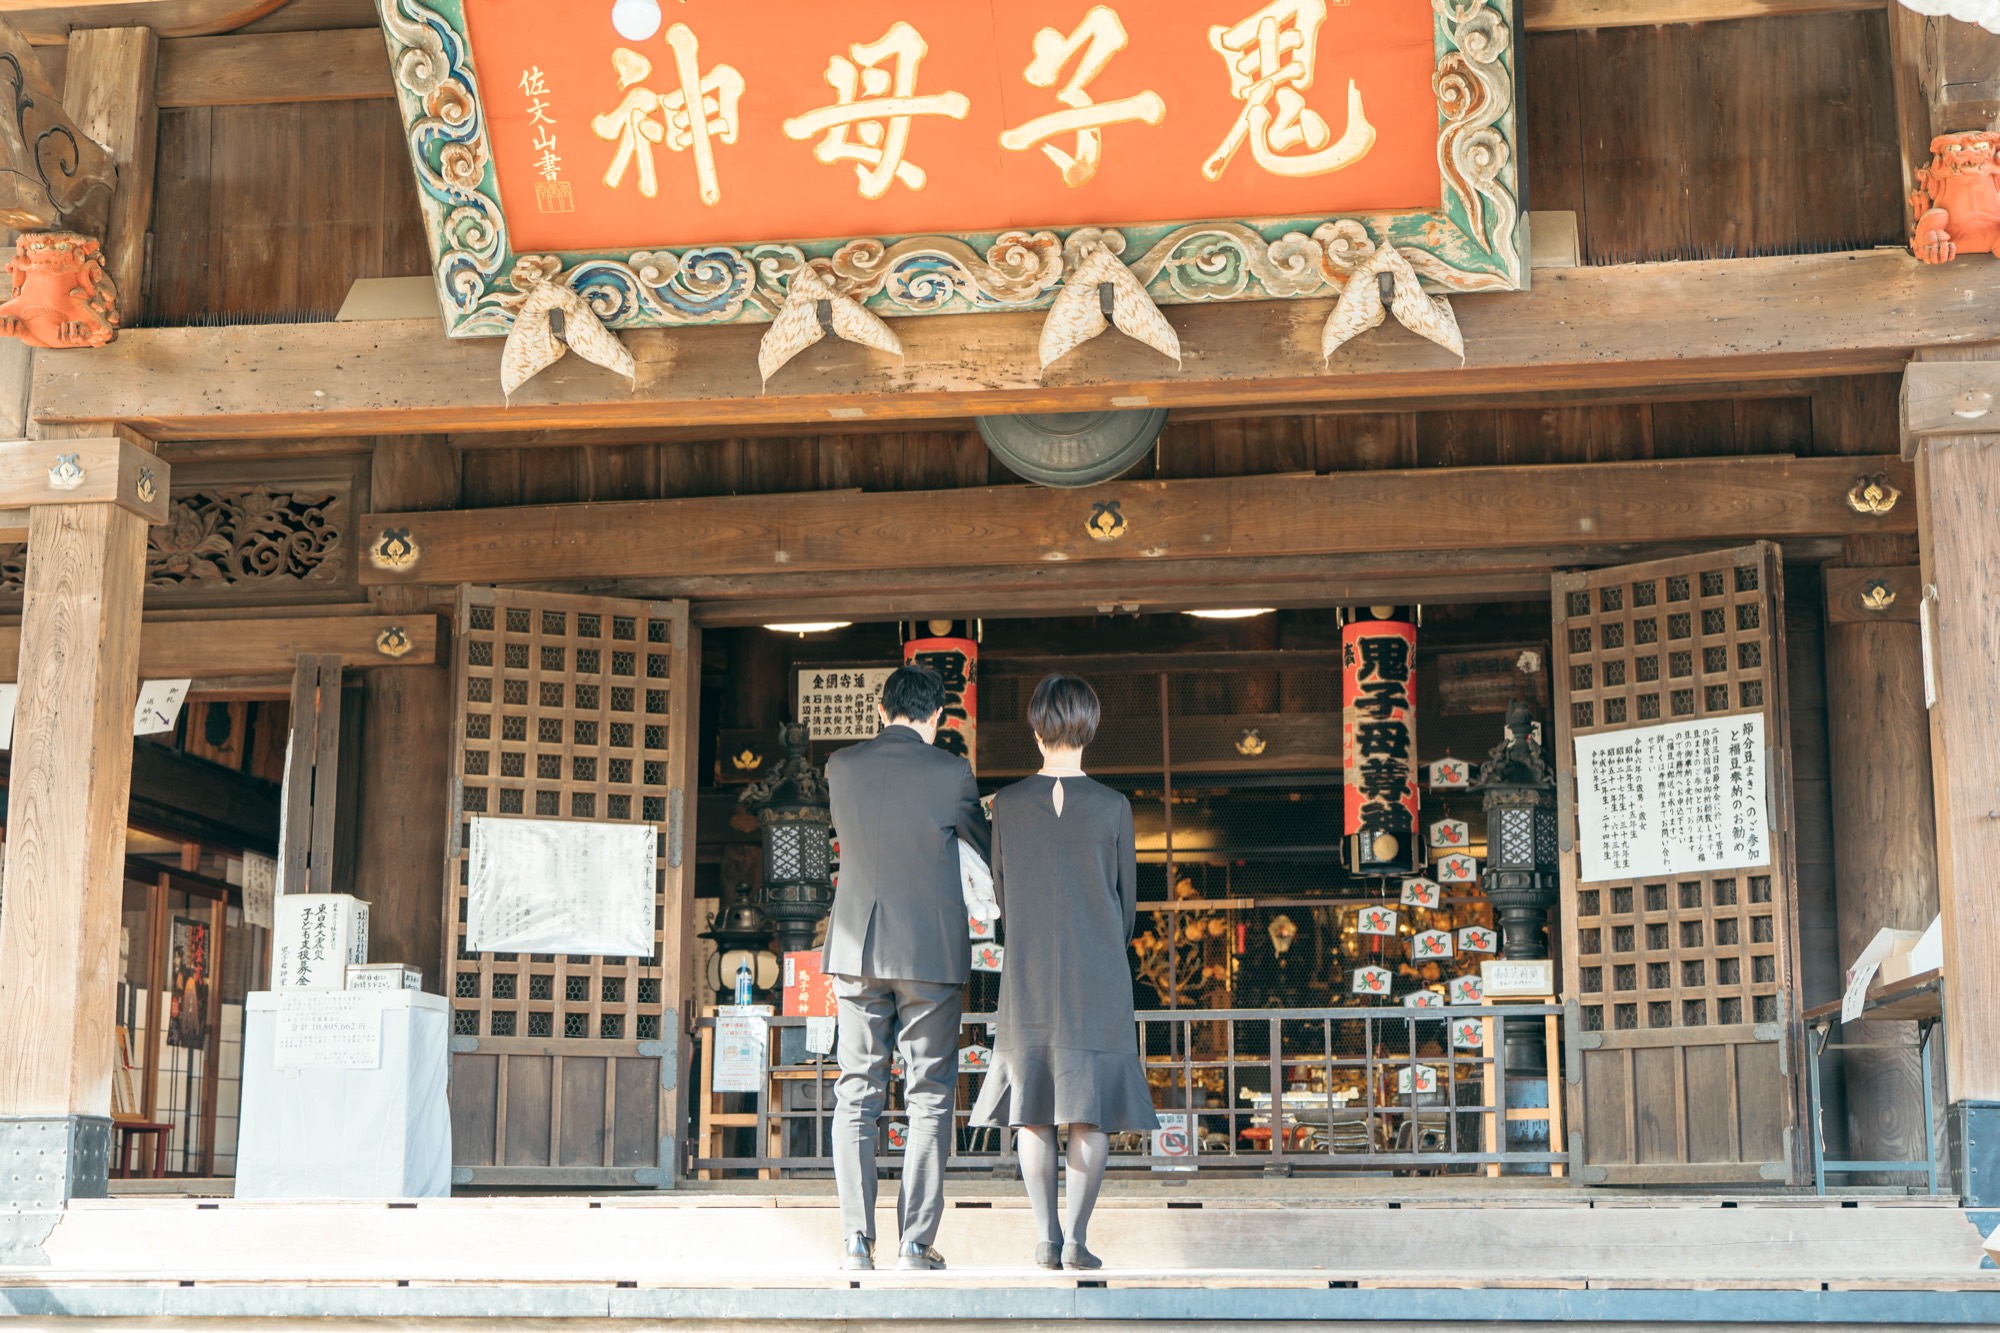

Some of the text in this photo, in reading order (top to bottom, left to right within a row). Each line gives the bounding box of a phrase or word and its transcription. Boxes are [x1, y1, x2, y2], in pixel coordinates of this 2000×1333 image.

[518, 65, 561, 181] 佐文山書
[591, 0, 1376, 206] 鬼子母神
[1728, 730, 1745, 851] と福豆奉納のお勧め
[1743, 722, 1760, 860] 節分豆まきへのご参加
[295, 907, 313, 986] 子ども支援募金
[312, 903, 327, 961] 東日本大震災
